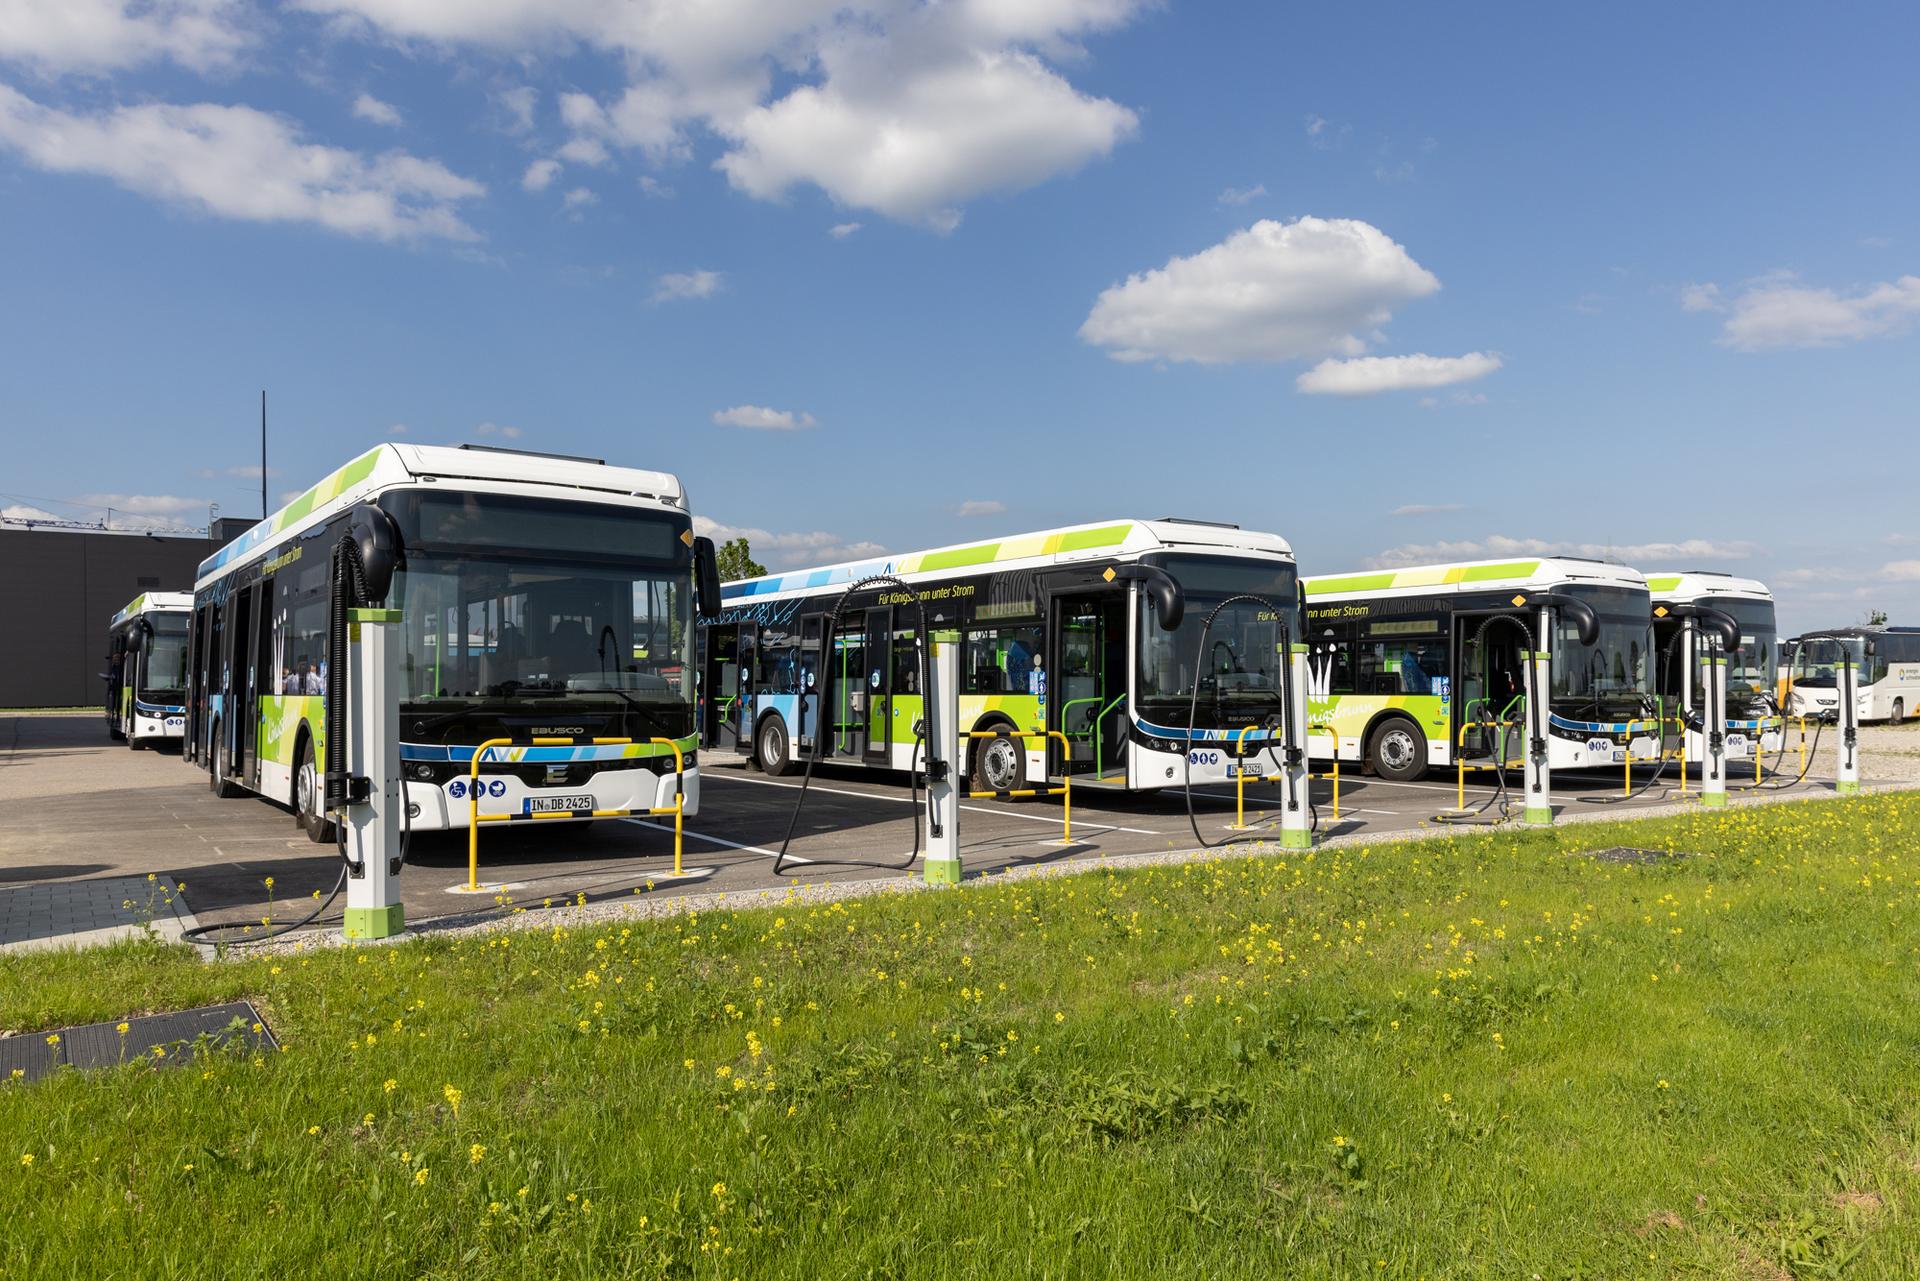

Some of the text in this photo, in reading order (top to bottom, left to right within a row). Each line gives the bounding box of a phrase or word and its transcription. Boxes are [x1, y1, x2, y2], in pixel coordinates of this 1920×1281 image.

[878, 593, 889, 605] Für
[931, 587, 952, 600] unter
[952, 584, 975, 598] Strom
[1320, 608, 1341, 618] unter
[1343, 605, 1369, 617] Strom
[531, 727, 584, 735] EBUSCO
[531, 797, 590, 811] IN DB 2425
